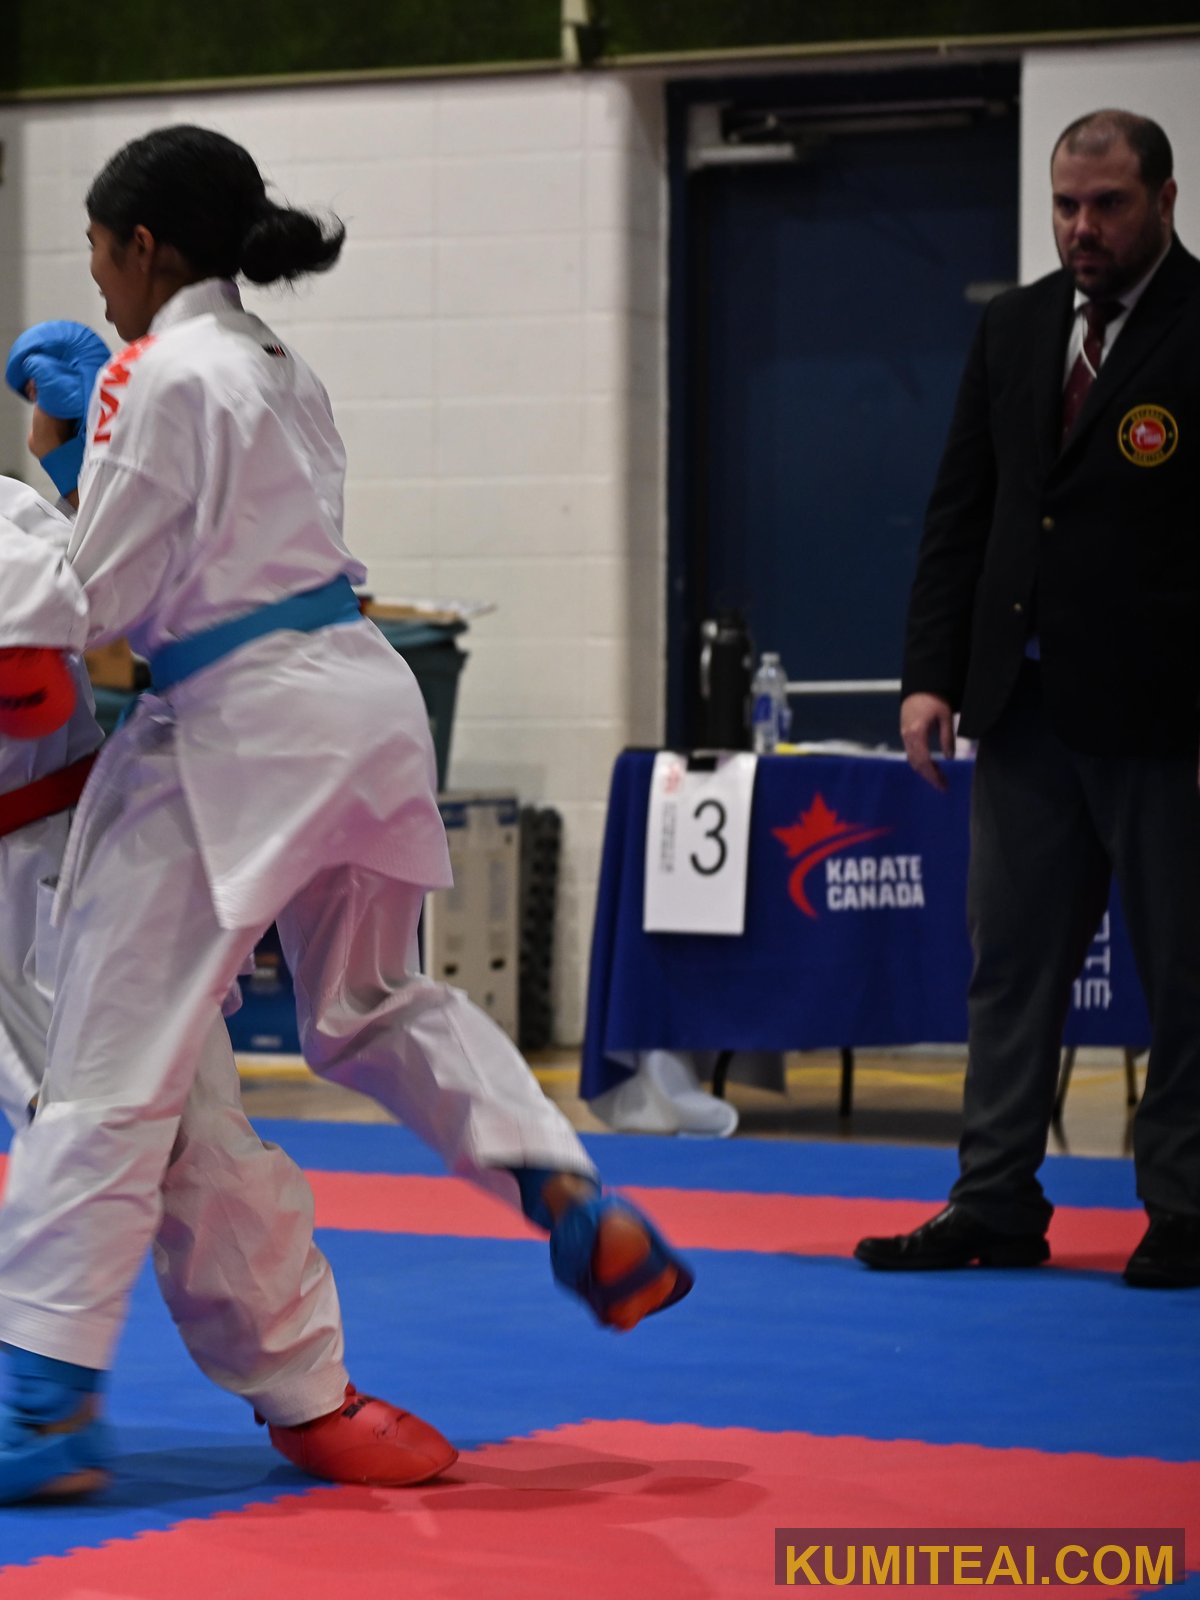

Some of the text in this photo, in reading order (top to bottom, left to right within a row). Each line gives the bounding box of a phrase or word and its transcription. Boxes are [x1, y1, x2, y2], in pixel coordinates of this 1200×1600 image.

[690, 798, 728, 876] 3
[825, 854, 922, 883] KARATE
[826, 882, 925, 911] CANADA
